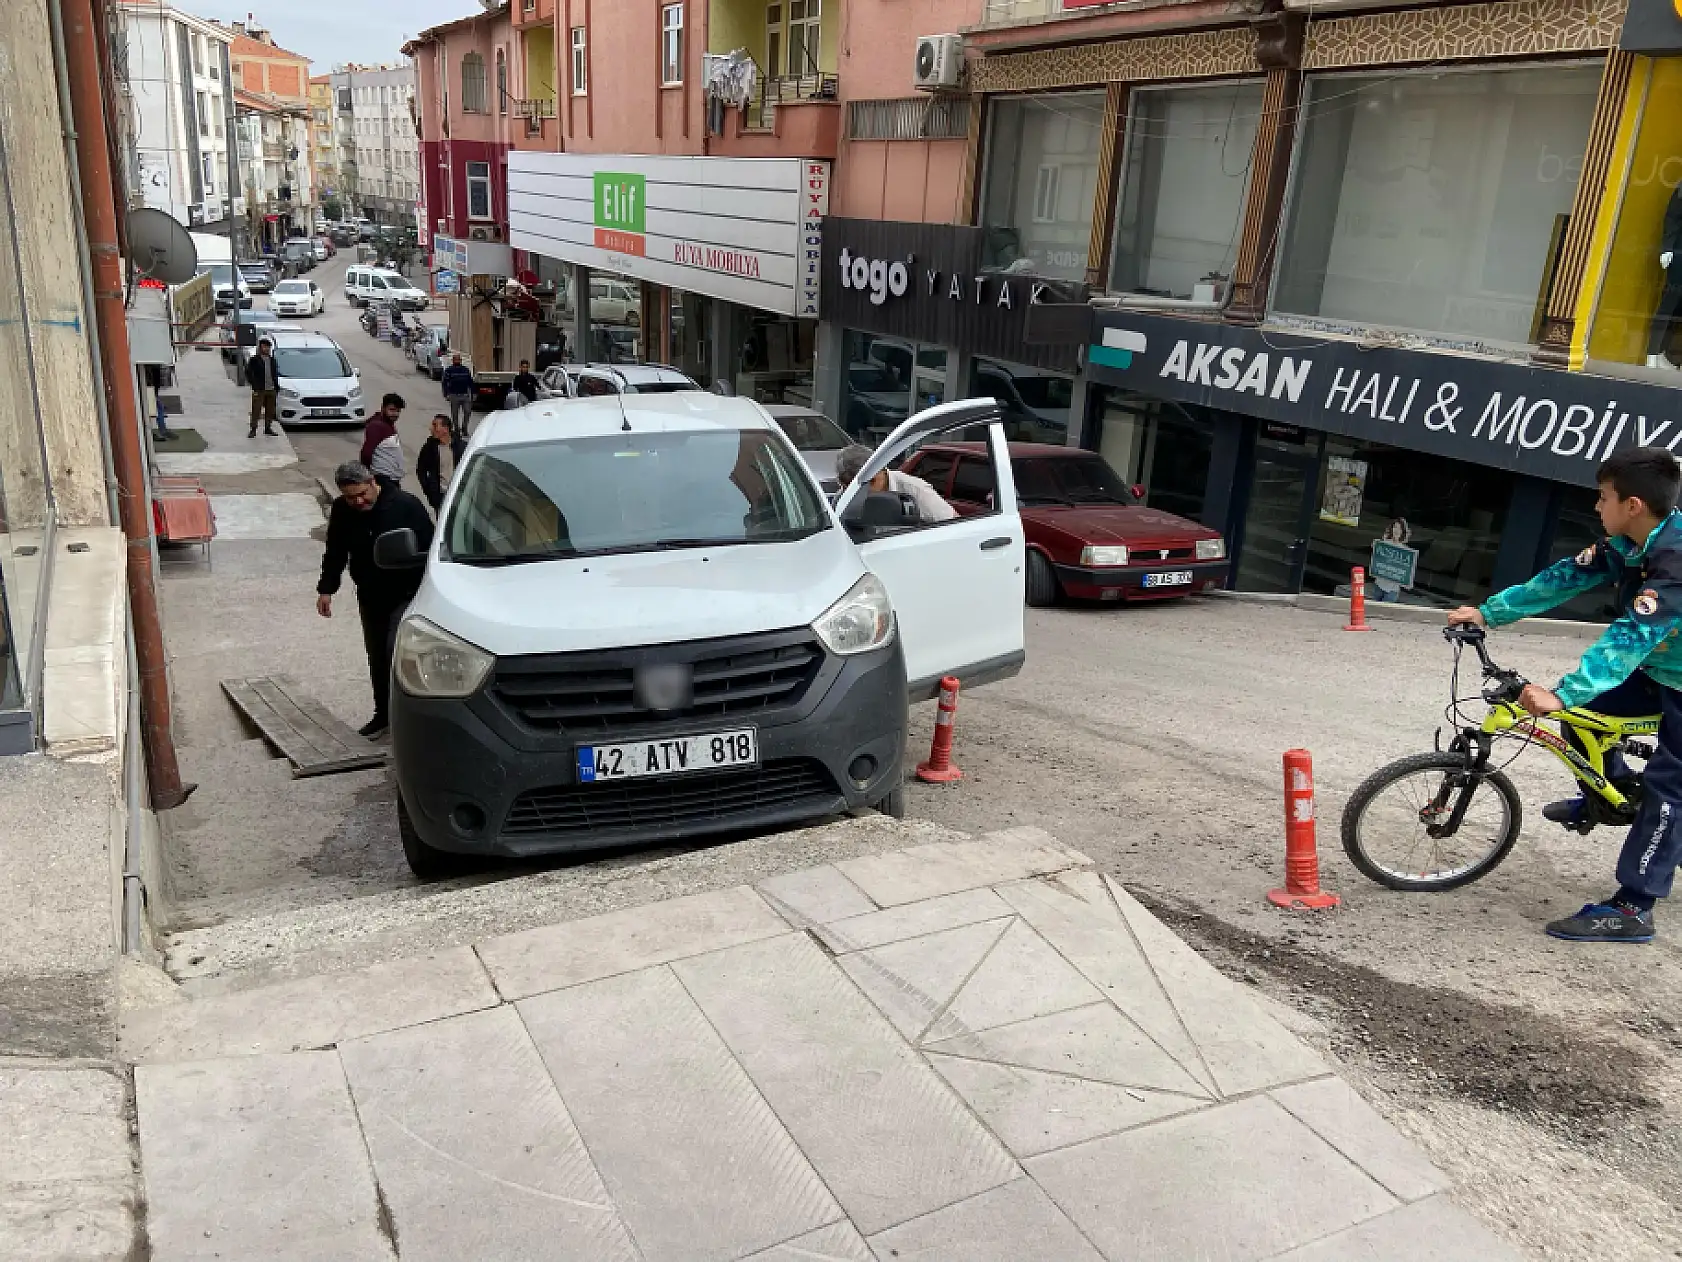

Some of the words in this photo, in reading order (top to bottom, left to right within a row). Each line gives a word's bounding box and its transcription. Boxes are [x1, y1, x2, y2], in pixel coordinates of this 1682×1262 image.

[603, 181, 636, 223] Elif
[838, 247, 908, 305] togo
[926, 269, 1047, 309] YATAK
[1159, 340, 1313, 403] AKSAN
[1325, 368, 1421, 424] HALI
[1424, 382, 1463, 433] &
[596, 748, 625, 777] 42
[645, 740, 688, 772] ATV
[710, 733, 750, 763] 818
